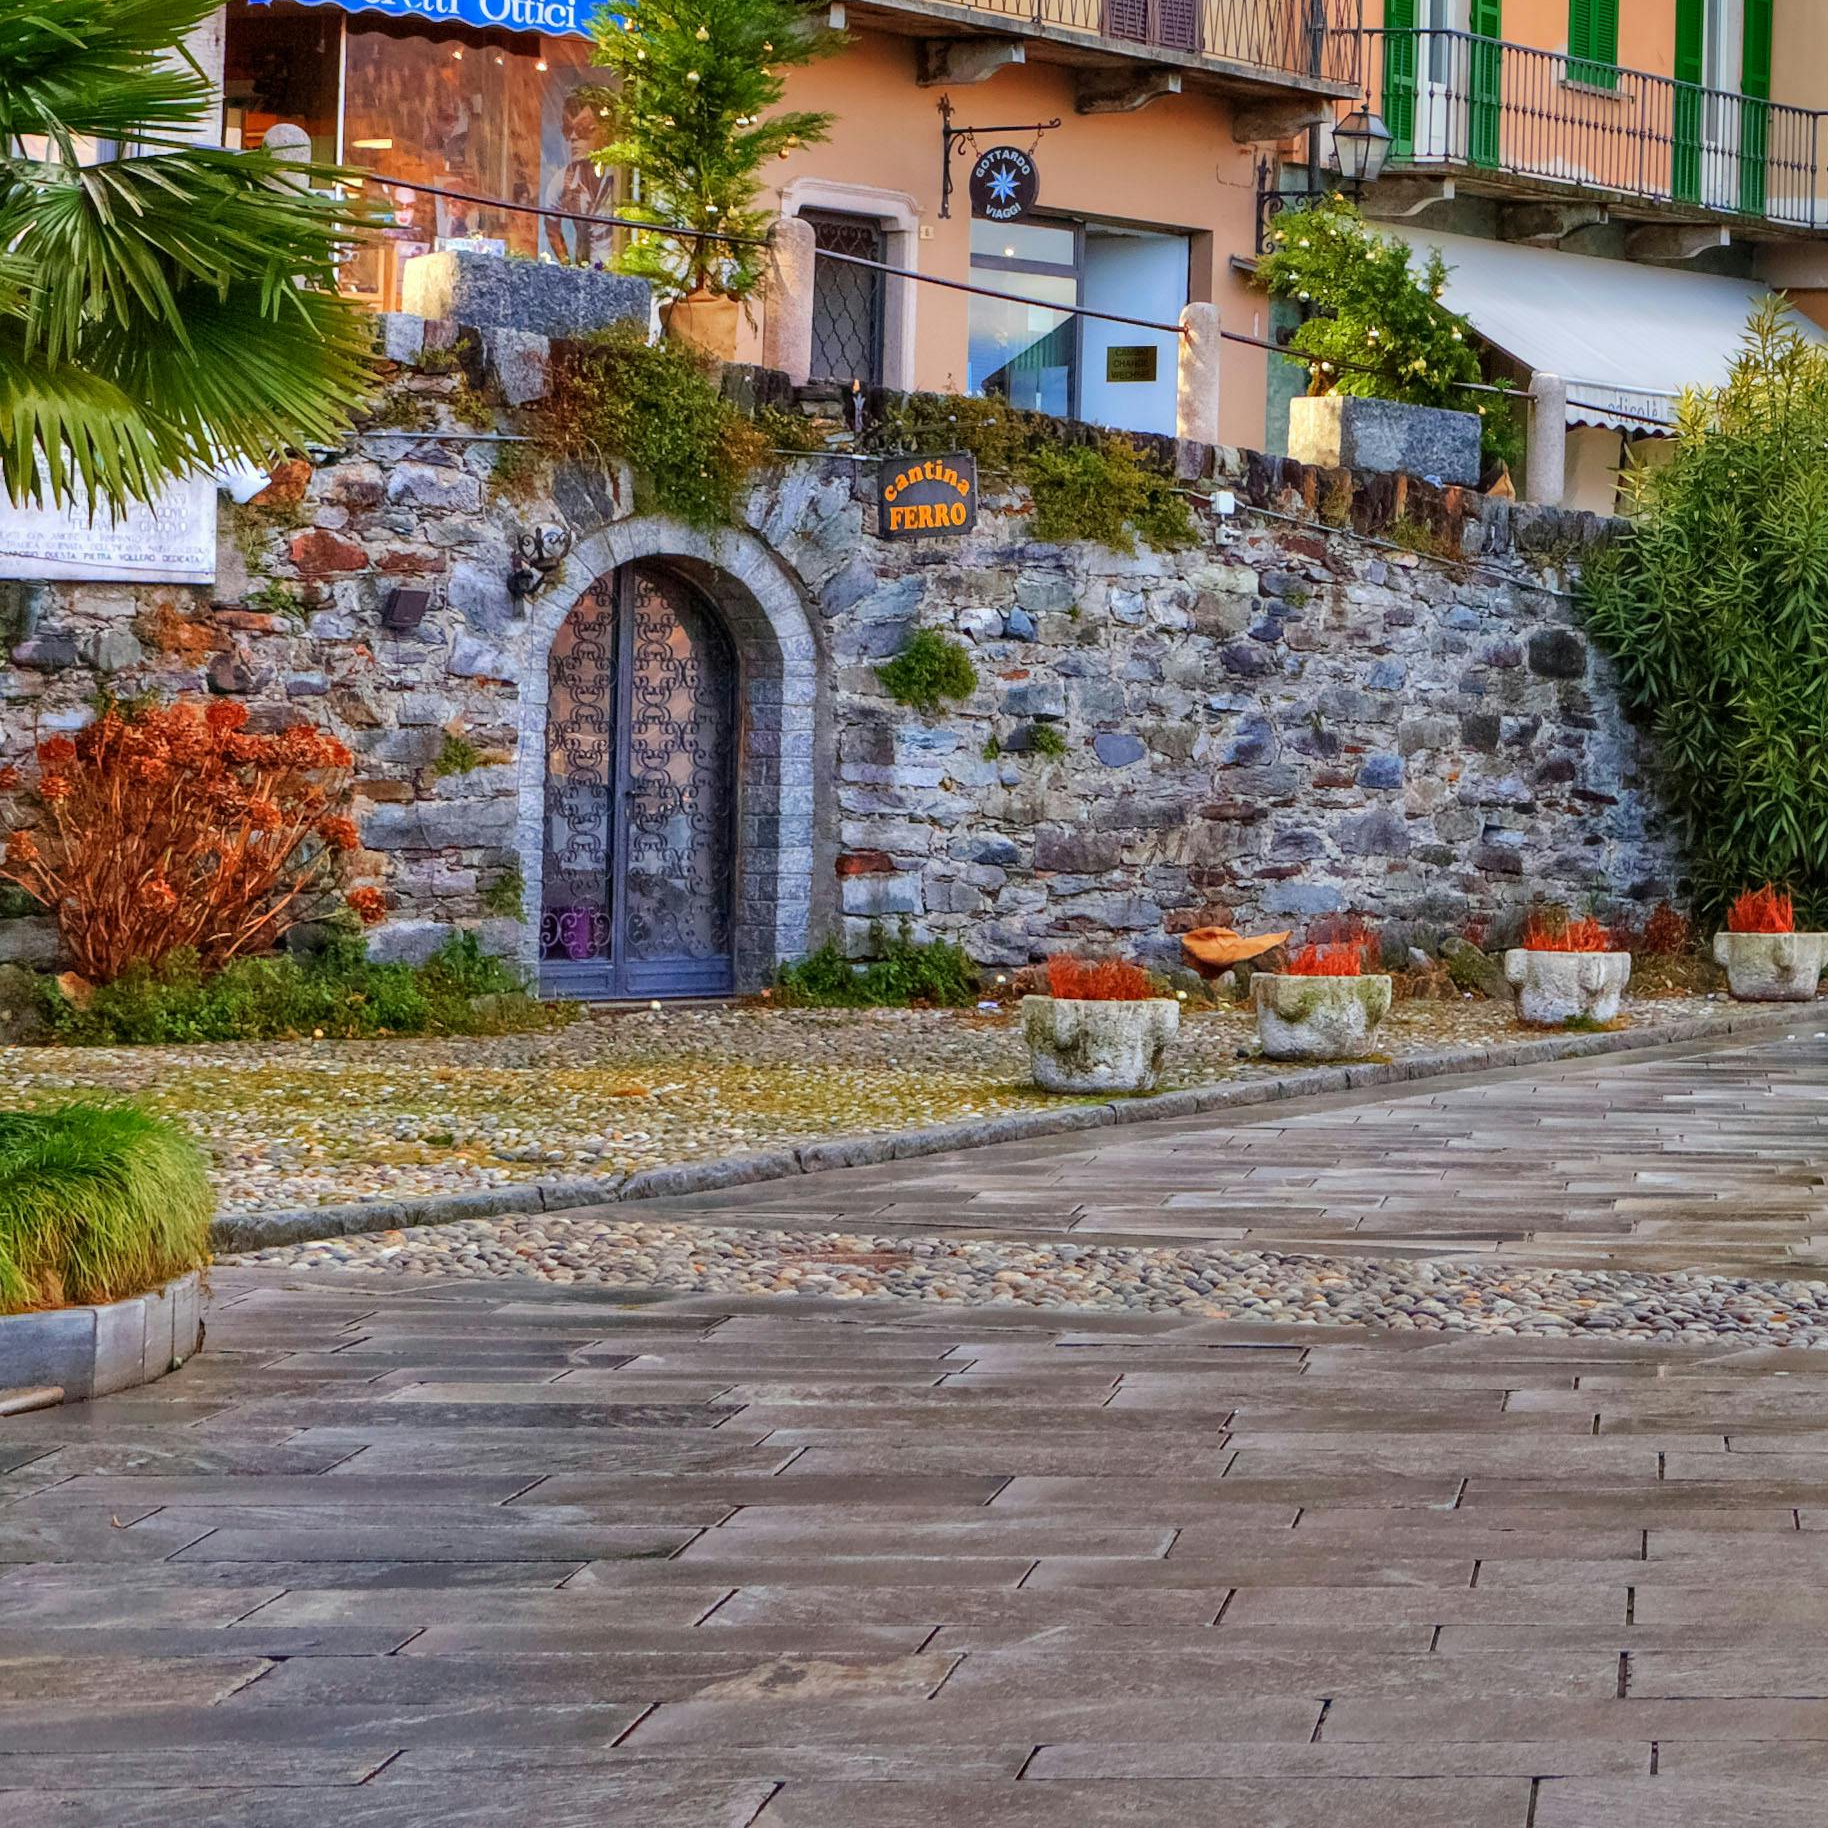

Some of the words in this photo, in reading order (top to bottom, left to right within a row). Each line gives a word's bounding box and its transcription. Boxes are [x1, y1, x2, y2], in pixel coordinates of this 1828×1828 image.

[976, 149, 1031, 178] GOTTARDO
[986, 202, 1022, 219] VIAGGI
[885, 459, 970, 502] cantina
[890, 502, 967, 531] FERRO
